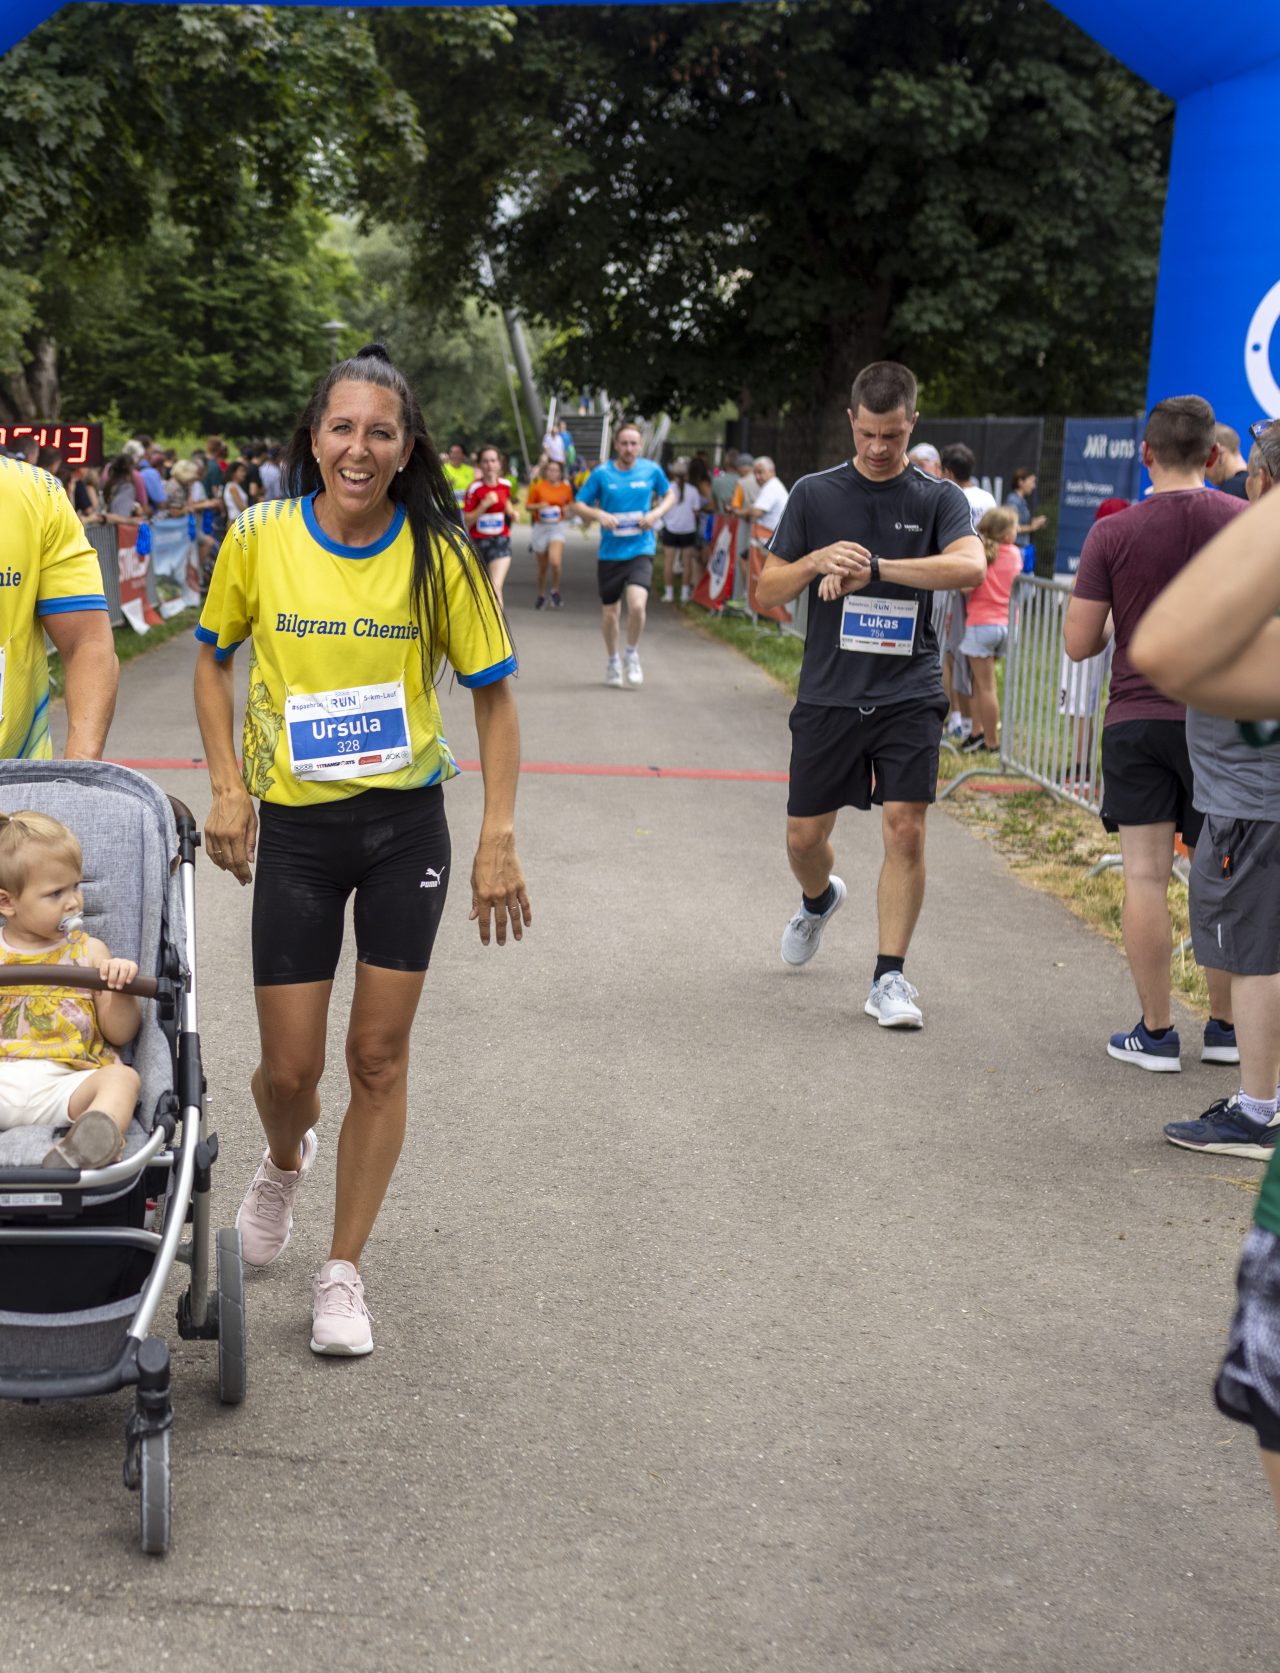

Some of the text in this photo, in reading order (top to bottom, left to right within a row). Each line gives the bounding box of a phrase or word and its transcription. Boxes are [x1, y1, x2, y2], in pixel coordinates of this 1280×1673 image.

[1109, 438, 1136, 459] uns
[275, 613, 419, 640] Bilgram Chemie
[860, 614, 899, 629] Lukas
[871, 629, 885, 638] 756
[331, 696, 357, 708] RUN
[312, 716, 381, 740] Ursula
[337, 740, 360, 753] 328
